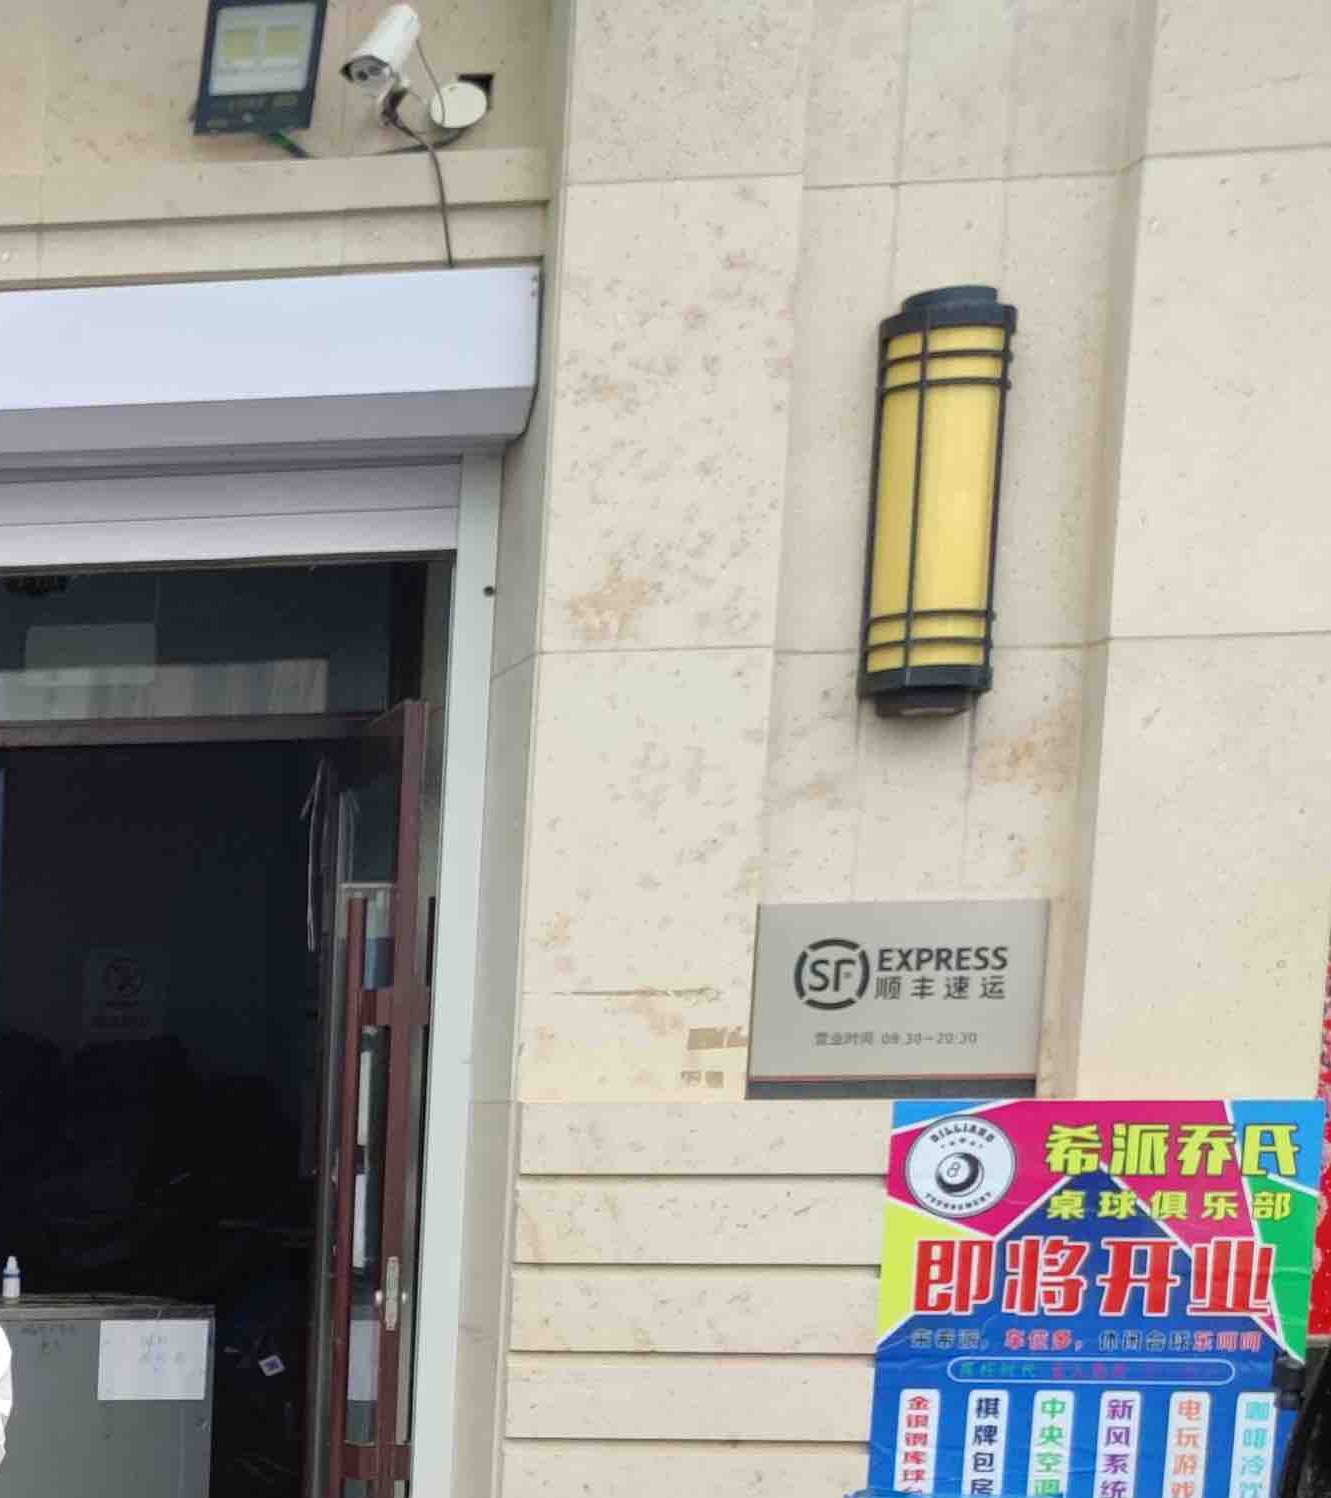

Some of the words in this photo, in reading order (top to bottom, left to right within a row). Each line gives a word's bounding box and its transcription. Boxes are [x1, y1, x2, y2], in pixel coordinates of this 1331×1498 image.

[877, 946, 1008, 972] EXPRESS
[875, 974, 1006, 1000] 顺丰速运
[1046, 1122, 1300, 1177] 希派乔氏
[1047, 1190, 1292, 1221] 桌球俱乐部
[911, 1235, 1277, 1317] 即将开业
[971, 1397, 1001, 1495] 棋牌包房
[1034, 1397, 1066, 1496] 中央空调
